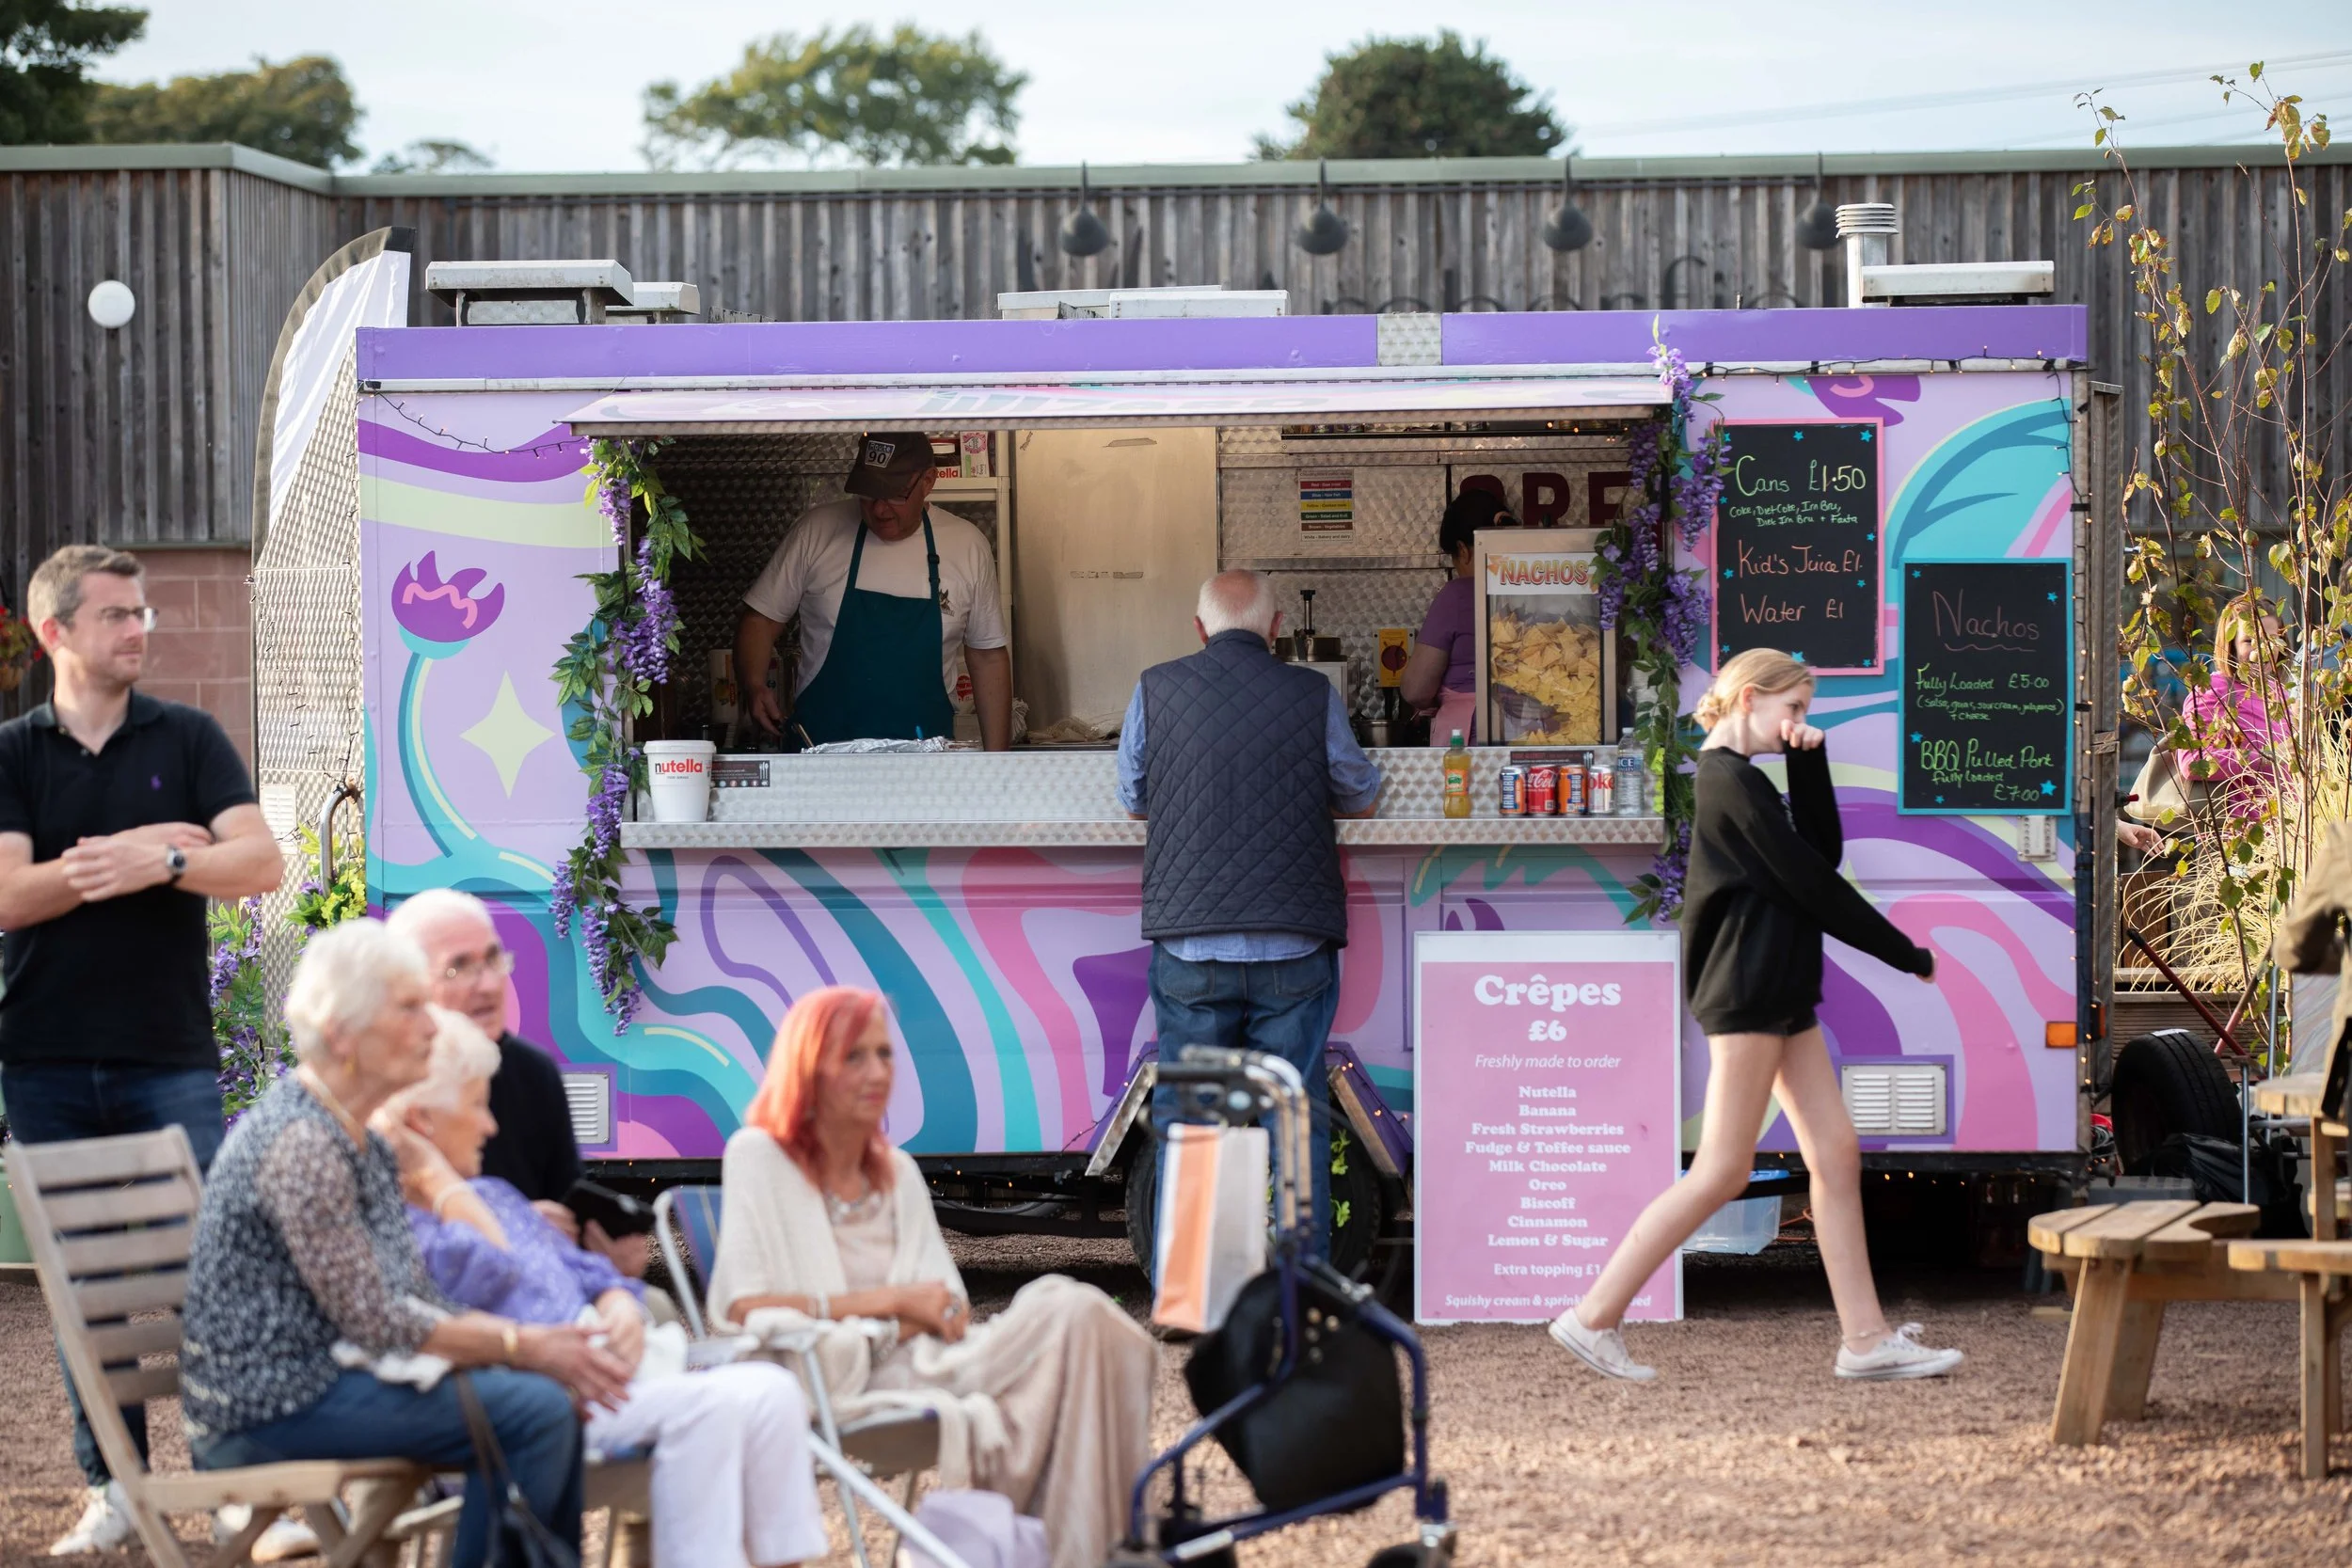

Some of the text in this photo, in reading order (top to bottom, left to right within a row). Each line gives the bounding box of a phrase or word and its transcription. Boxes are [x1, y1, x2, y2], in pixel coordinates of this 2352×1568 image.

[868, 442, 892, 453] Route
[867, 451, 887, 465] 90
[1736, 455, 1790, 497] Cans
[1729, 506, 1756, 518] Coke,
[1801, 500, 1819, 512] Irn
[1820, 499, 1842, 513] Bru,
[1756, 517, 1776, 527] Diet
[1778, 515, 1794, 525] Irn
[1797, 515, 1814, 524] Bru
[1831, 513, 1859, 524] Fanta
[1738, 539, 1789, 579] Kid's
[1791, 545, 1839, 573] Juice
[1501, 560, 1589, 585] NACHOS
[1740, 594, 1844, 625] Water £1
[1932, 587, 2040, 641] Nachos
[1915, 662, 1947, 697] Fully
[1949, 672, 1994, 691] Loaded
[1920, 737, 2055, 772] BBQ Pulled Pork
[655, 758, 703, 773] nutella
[1474, 974, 1621, 1012] Crêpes
[1528, 1020, 1567, 1041] £6
[1475, 1053, 1621, 1070] Freshly made to order
[1518, 1085, 1577, 1098] Nutella
[1518, 1104, 1577, 1117] Banana
[1471, 1123, 1625, 1135] Fresh Strawberries
[1465, 1141, 1631, 1156] Fudge & Toffee sauce
[1489, 1160, 1607, 1172] Milk Chocolate
[1529, 1179, 1566, 1191] Oreo
[1520, 1196, 1577, 1210] Biscoff
[1507, 1215, 1588, 1228] Cinnamon
[1487, 1234, 1609, 1249] Lemon & Sugar
[1494, 1263, 1528, 1275] Extra
[1530, 1263, 1582, 1278] topping
[1445, 1294, 1583, 1308] Squishy cream & sprink
